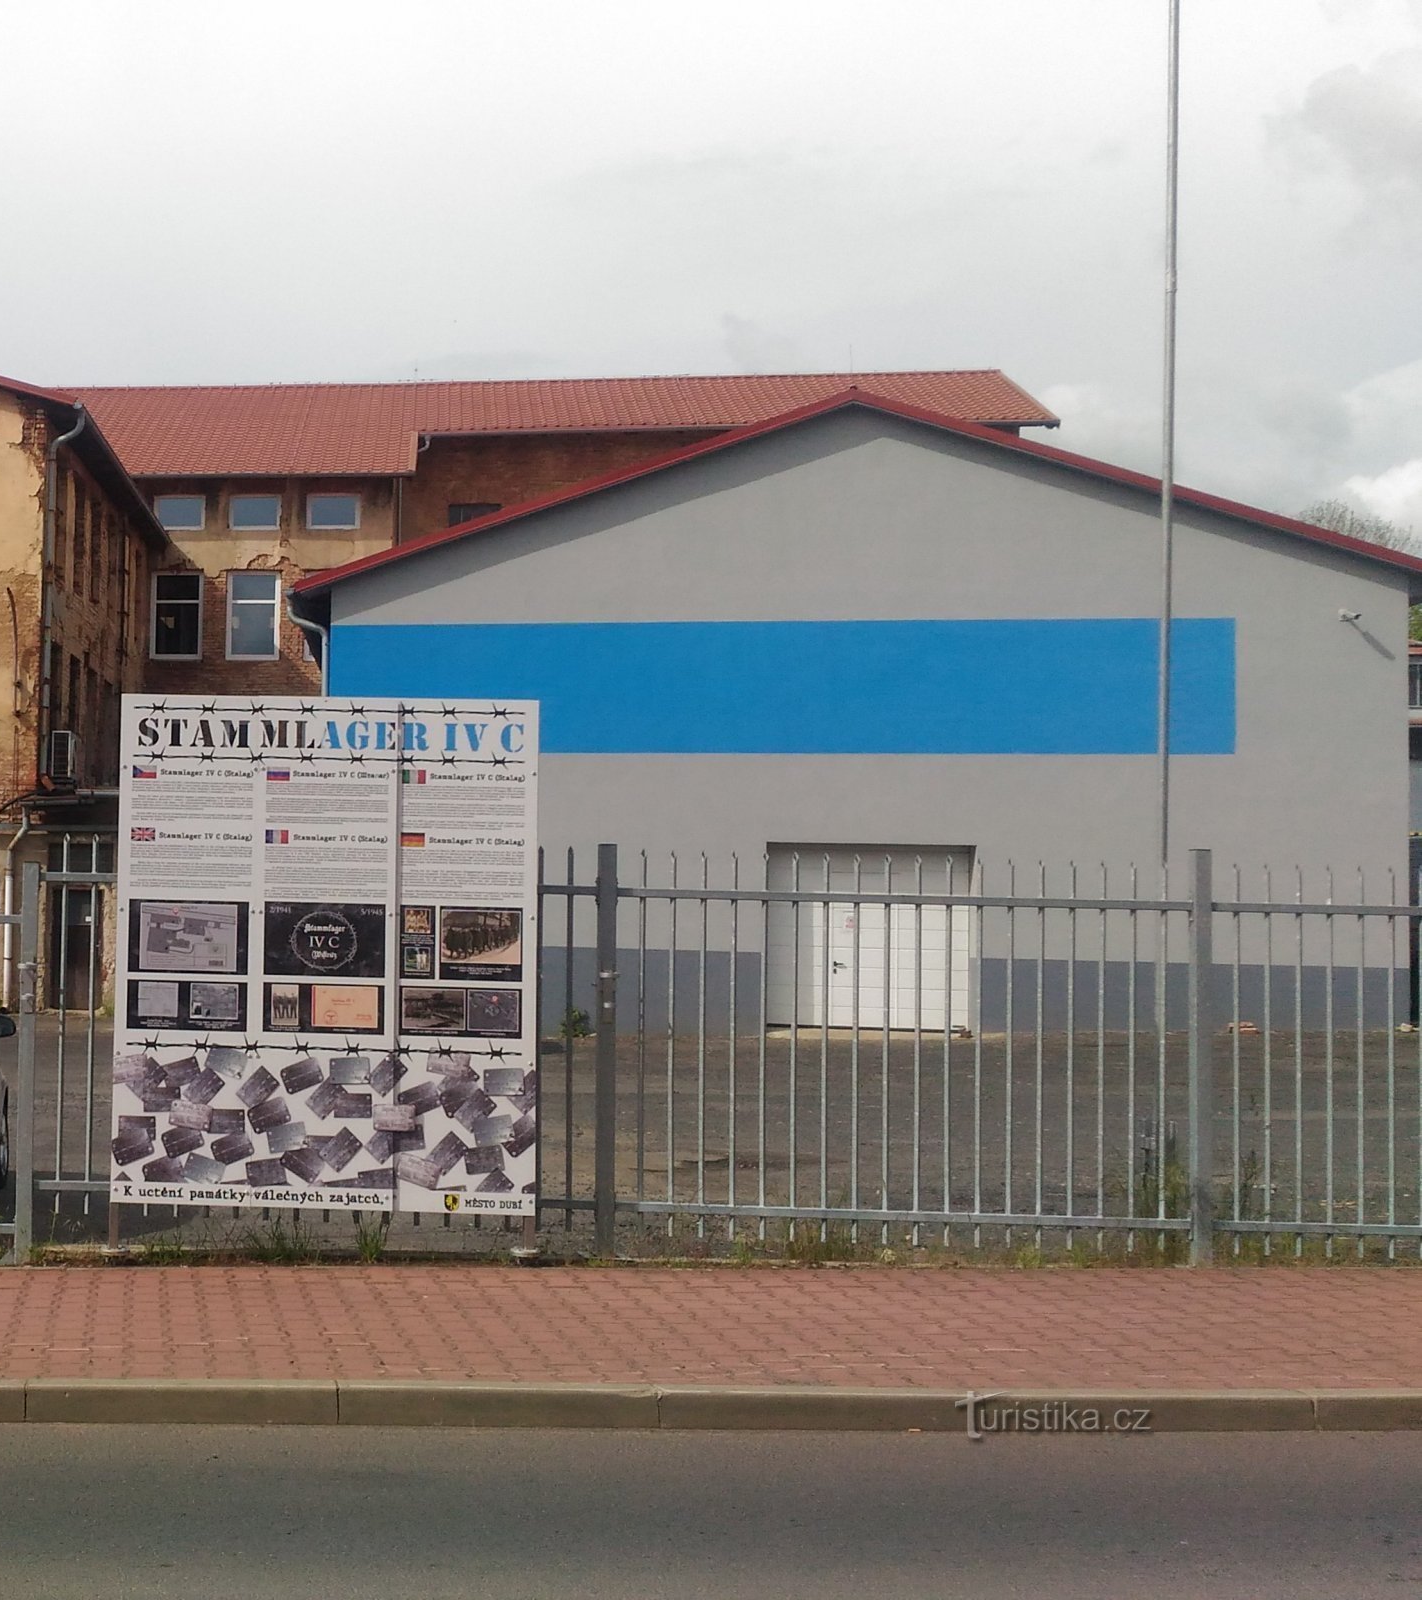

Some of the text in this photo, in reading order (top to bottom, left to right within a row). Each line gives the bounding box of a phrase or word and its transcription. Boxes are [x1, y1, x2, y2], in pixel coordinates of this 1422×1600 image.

[138, 717, 523, 752] STAMMLAGER IV C
[161, 769, 202, 777] Stammlager
[160, 832, 201, 840] Stammlager
[430, 837, 472, 845] Stammlager
[310, 936, 339, 948] IV C
[124, 1186, 383, 1205] K uctění památky válečných zajatců.
[465, 1198, 495, 1208] MĚSTO
